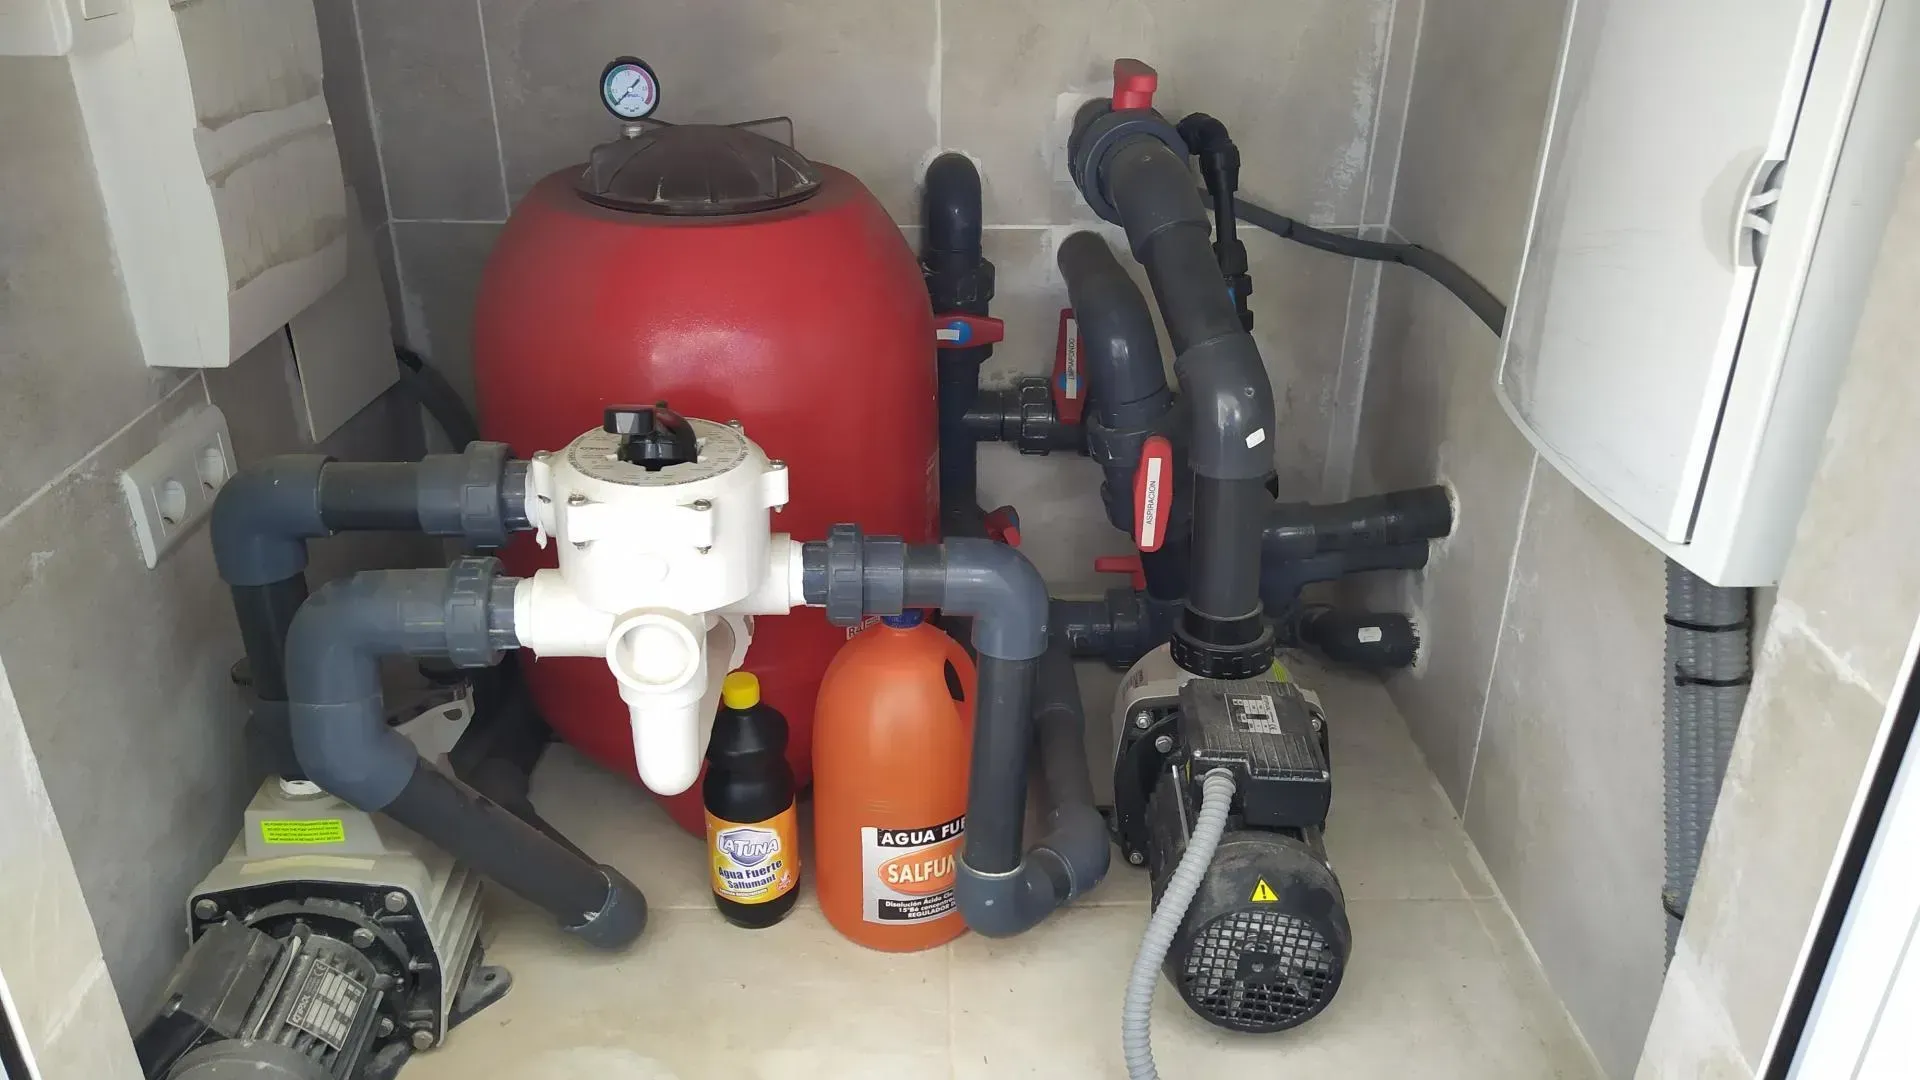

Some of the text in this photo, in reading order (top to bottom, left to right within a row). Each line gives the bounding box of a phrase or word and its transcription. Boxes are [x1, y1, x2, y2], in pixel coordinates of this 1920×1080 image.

[1146, 480, 1156, 525] ASPIRACION
[881, 829, 936, 846] AGUA
[718, 859, 783, 880] Agua Fuerte
[907, 902, 950, 918] REGULADOR
